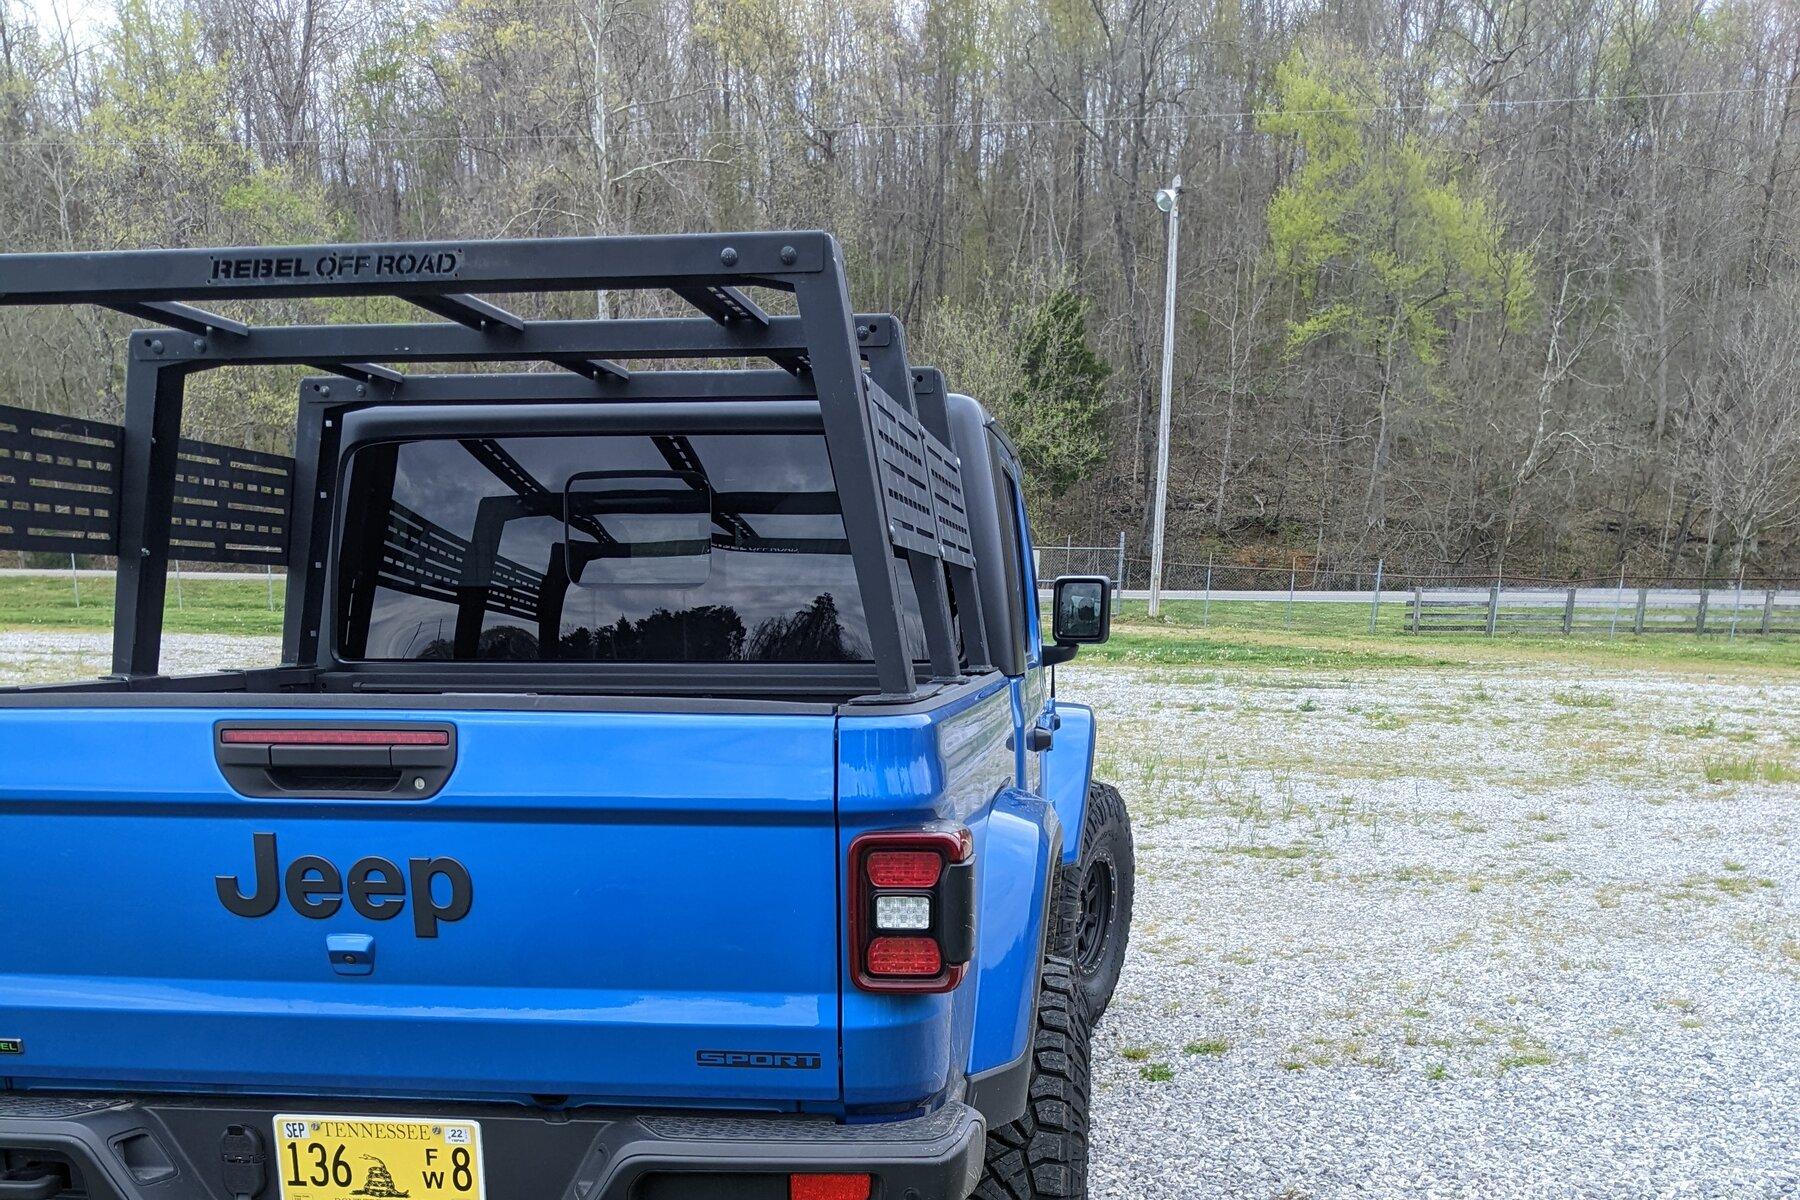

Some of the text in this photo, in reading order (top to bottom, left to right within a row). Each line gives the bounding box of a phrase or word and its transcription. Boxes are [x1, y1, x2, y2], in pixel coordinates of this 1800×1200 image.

[211, 253, 457, 280] REBEL OFF ROAD
[215, 832, 473, 938] Jeep
[697, 1051, 821, 1069] SPORT
[285, 1122, 305, 1138] SEP
[320, 1121, 431, 1141] TENNESSEE
[450, 1129, 463, 1138] 22
[287, 1141, 352, 1188] 136
[451, 1147, 473, 1192] 8
